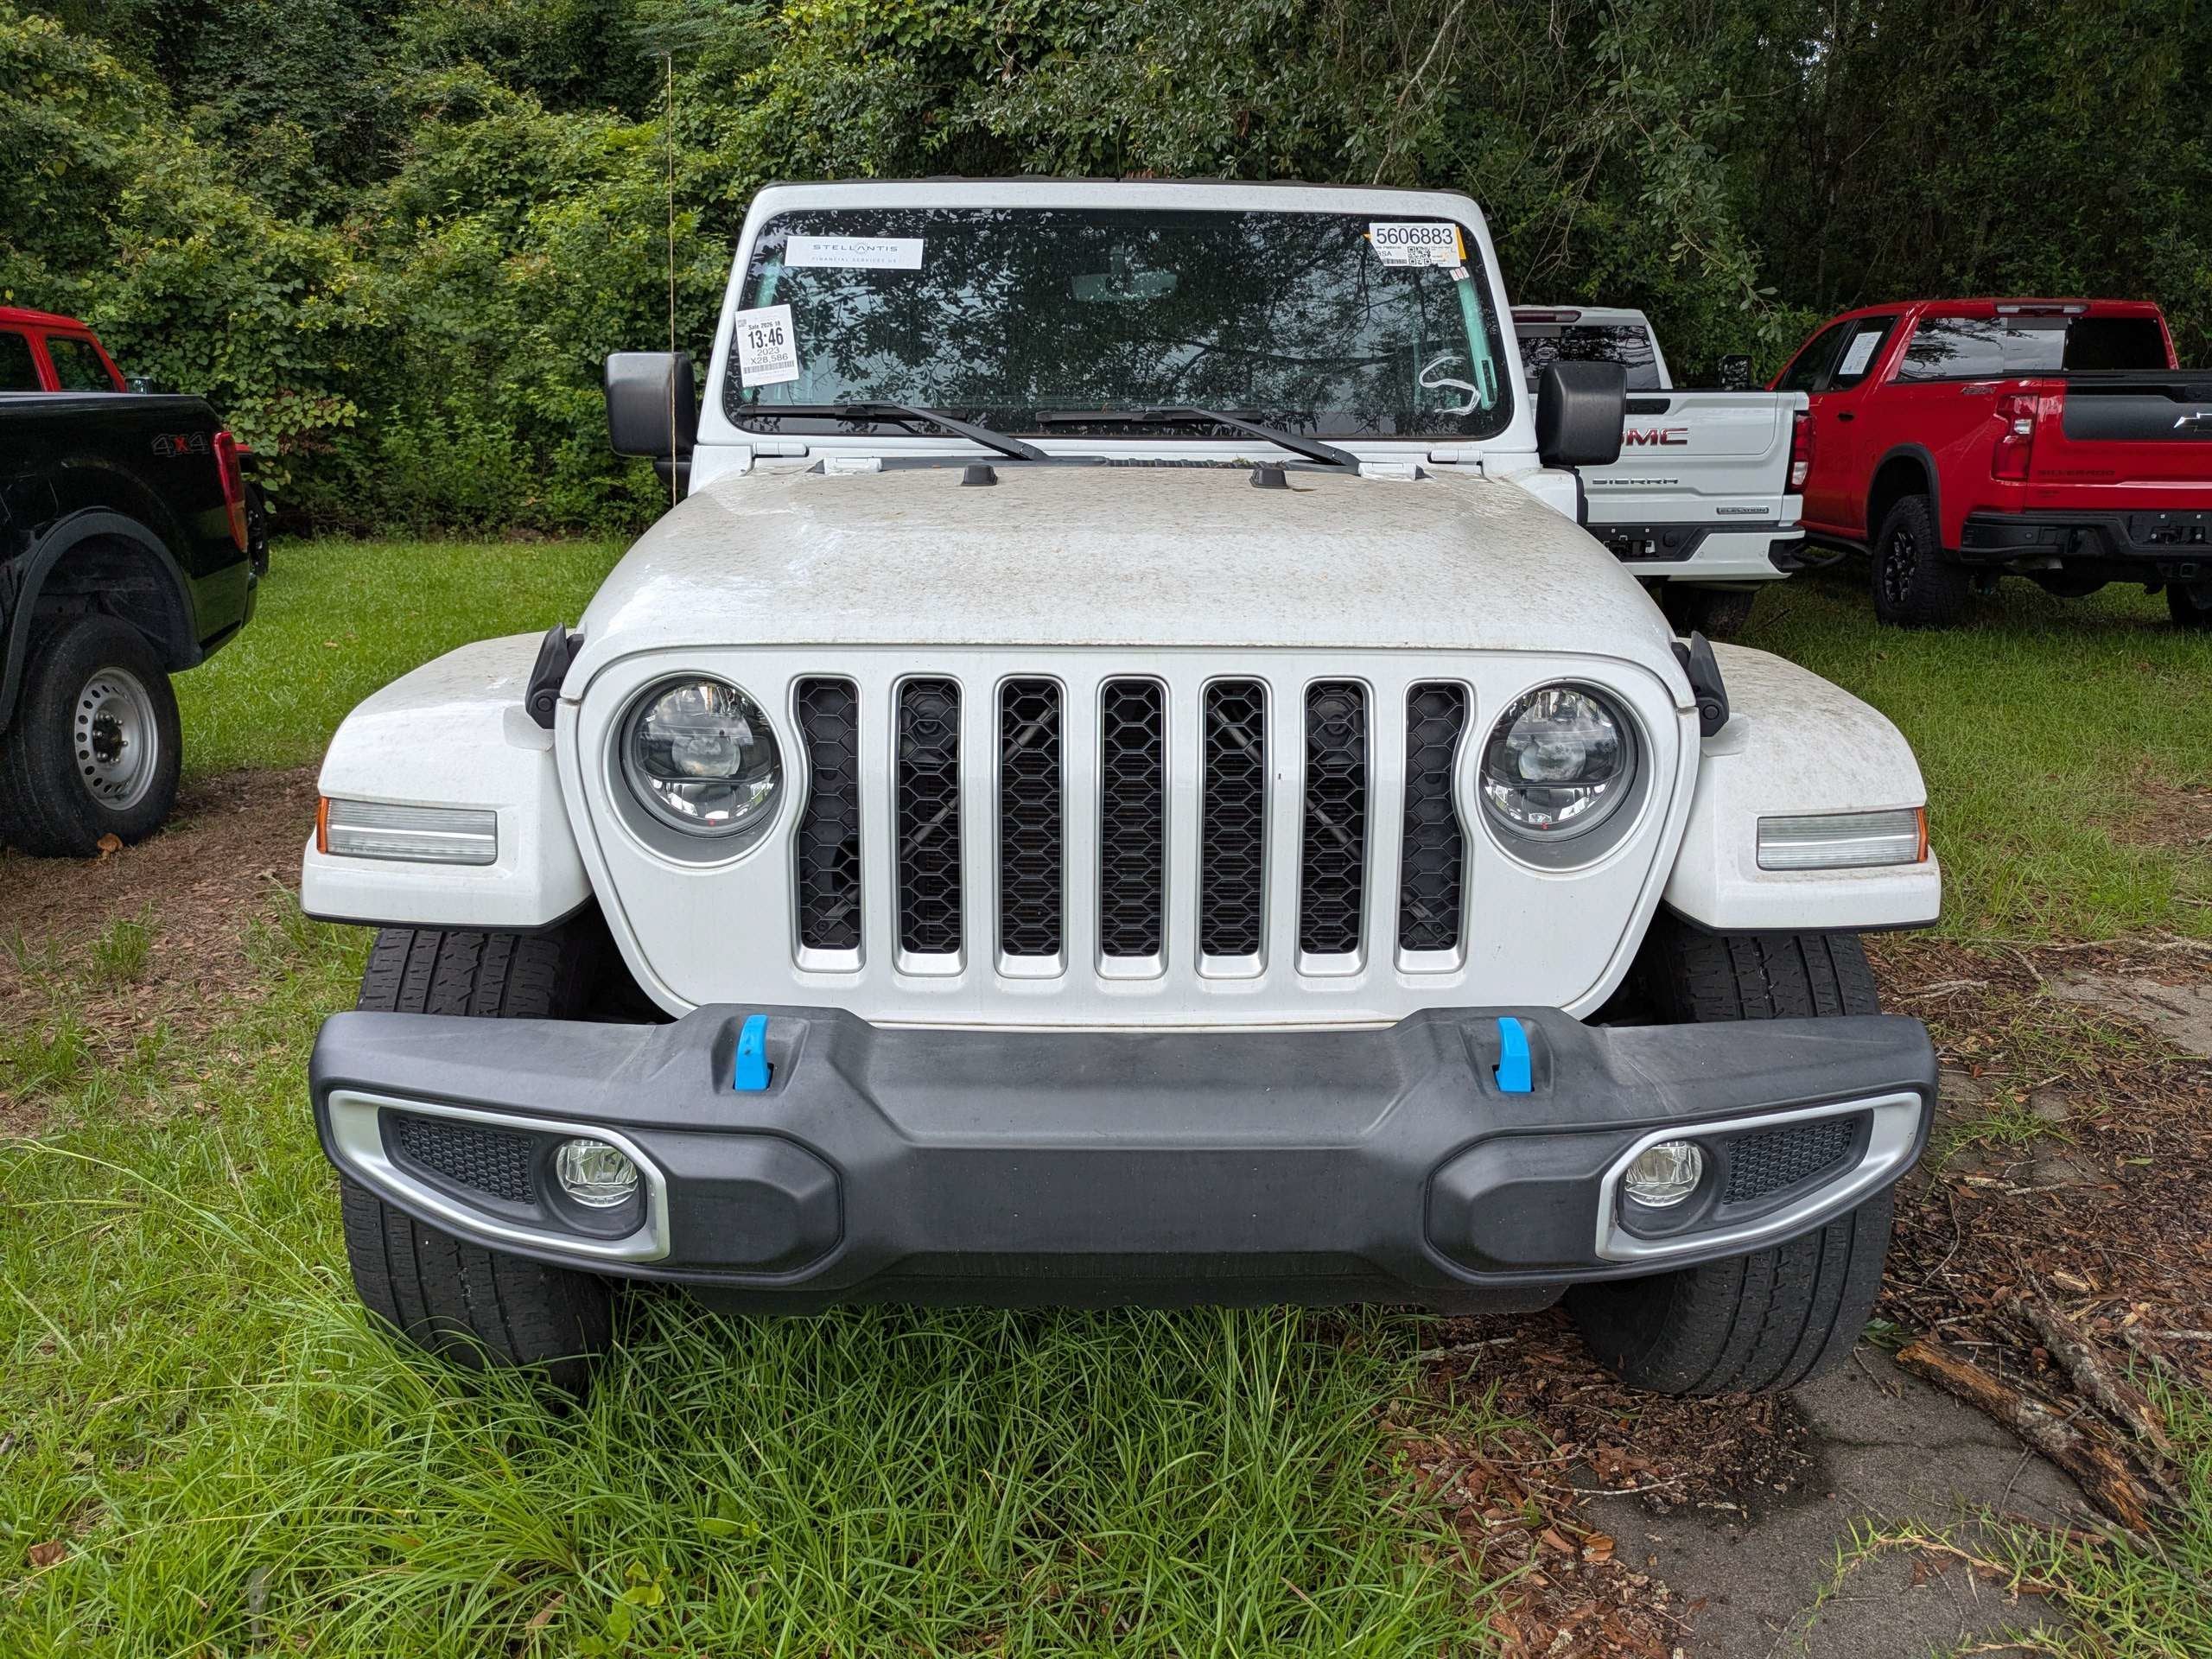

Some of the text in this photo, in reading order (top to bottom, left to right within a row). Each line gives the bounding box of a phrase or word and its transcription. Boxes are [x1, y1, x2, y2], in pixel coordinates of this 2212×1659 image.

[1376, 227, 1453, 245] 5606883
[812, 243, 899, 253] STELLANTIS
[748, 327, 784, 349] 13:46
[757, 346, 780, 356] 2023
[1621, 428, 1688, 446] MC
